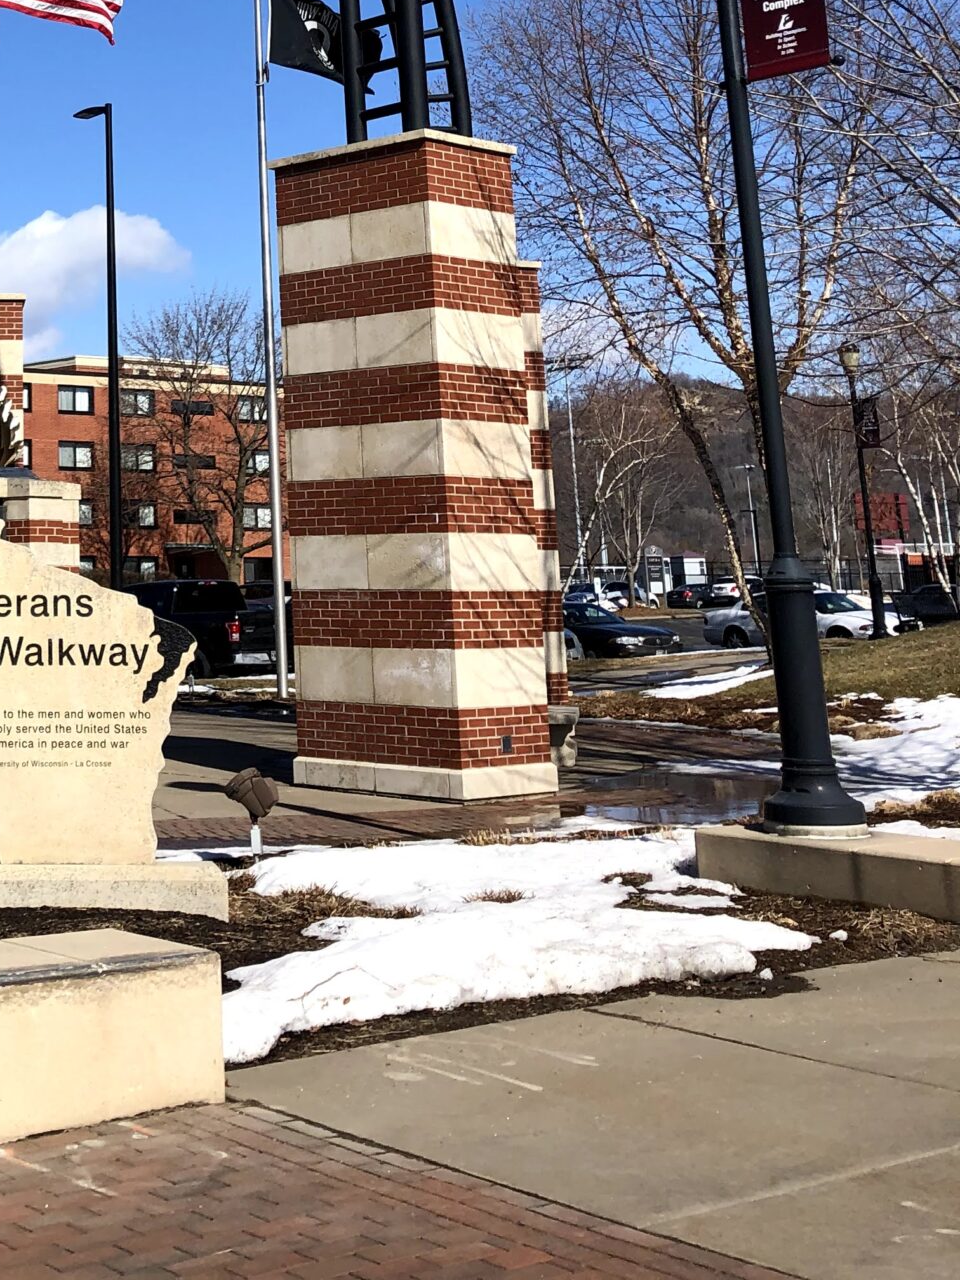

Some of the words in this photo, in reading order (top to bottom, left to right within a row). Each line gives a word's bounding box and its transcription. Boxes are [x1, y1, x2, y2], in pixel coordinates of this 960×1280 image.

[3, 709, 14, 719] to
[17, 709, 34, 719] the
[37, 711, 61, 719] men
[64, 709, 84, 719] and
[87, 711, 125, 719] women
[129, 709, 151, 719] who
[15, 724, 52, 734] served
[55, 724, 72, 734] the
[75, 724, 110, 734] United
[113, 724, 148, 734] States
[37, 738, 47, 748] in
[51, 740, 83, 751] peace
[86, 739, 107, 749] and
[110, 740, 130, 749] war
[21, 760, 29, 768] of
[31, 760, 69, 768] Wisconsin
[75, 760, 84, 768] La
[85, 760, 112, 768] Crosse
